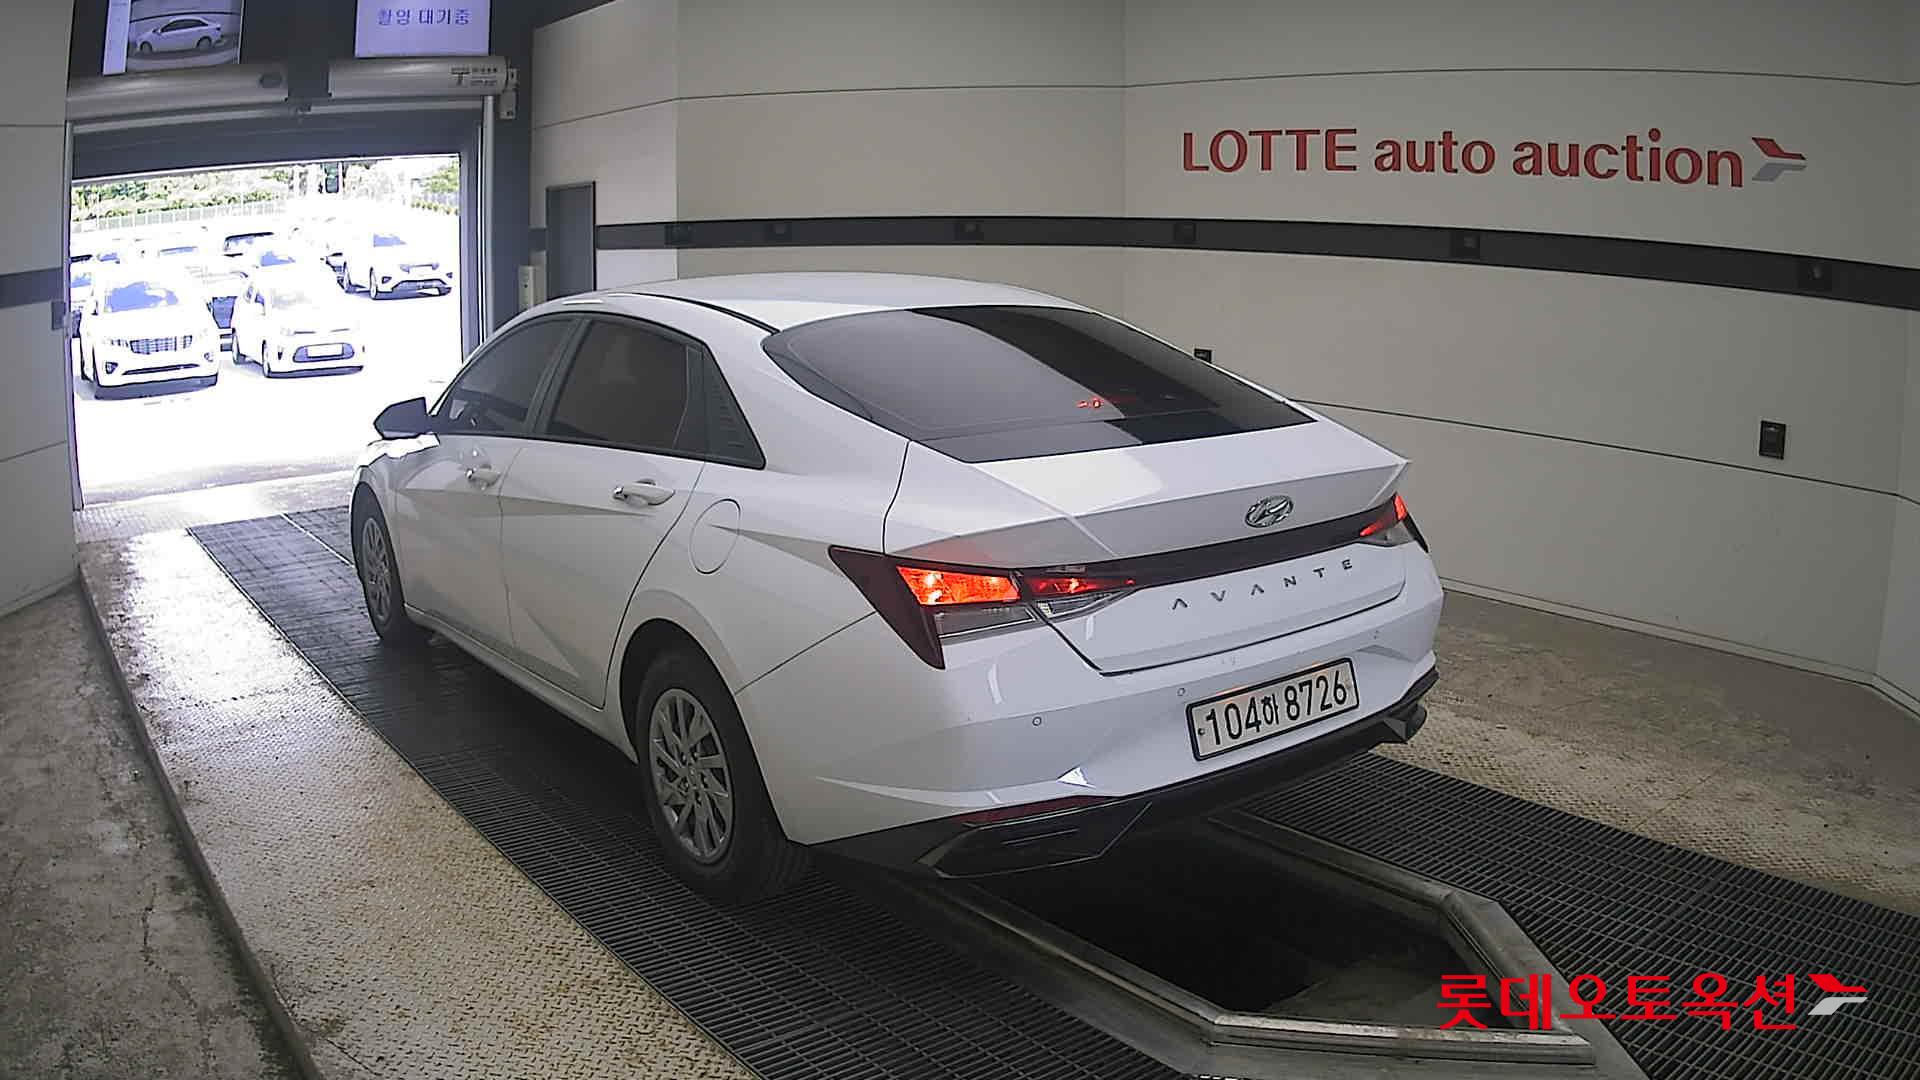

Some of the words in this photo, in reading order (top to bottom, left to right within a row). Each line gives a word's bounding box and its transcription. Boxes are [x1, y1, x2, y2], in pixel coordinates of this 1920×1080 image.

[418, 8, 471, 26] 대기중
[1184, 128, 1358, 173] LOTTE
[1374, 131, 1496, 175] auto
[1512, 128, 1744, 187] auction
[1171, 558, 1354, 611] AVANTE
[1284, 670, 1348, 722] 8726
